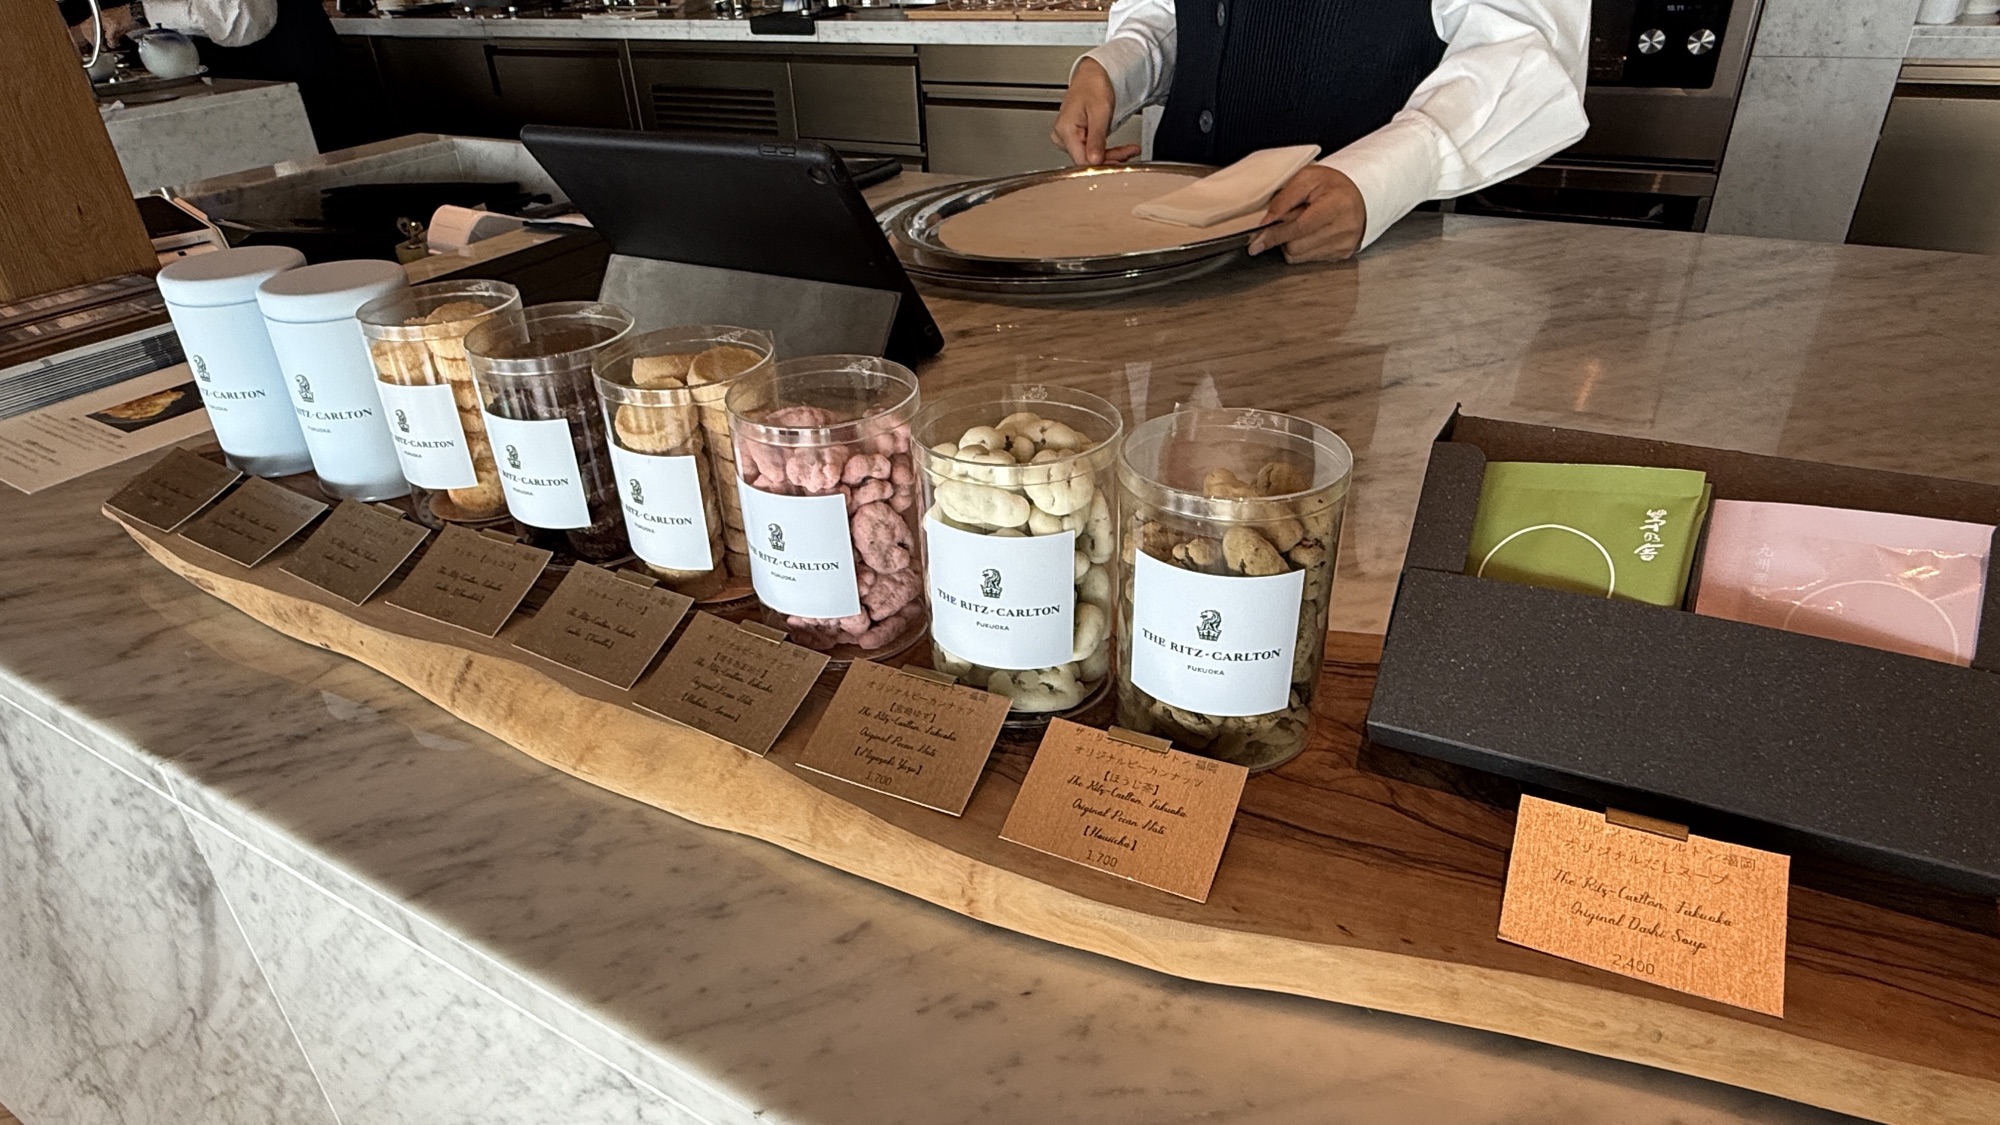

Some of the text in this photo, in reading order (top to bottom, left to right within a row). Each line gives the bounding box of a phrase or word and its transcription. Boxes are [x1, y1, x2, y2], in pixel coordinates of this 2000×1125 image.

[625, 503, 693, 525] RITZ-CARLTON
[758, 550, 840, 571] RITZ-CARLTON
[937, 587, 1061, 618] THE RITZ-CARLTON
[975, 620, 1010, 632] FUKUOKA
[1142, 627, 1282, 663] THE RITZ-CARLTON
[1186, 664, 1225, 677] FUKUOKA
[1067, 775, 1084, 788] The
[1148, 799, 1188, 818] Fukuoka
[1072, 798, 1167, 836] Original Pecan Nuts
[1086, 849, 1119, 868] 1,700
[1552, 868, 1576, 886] The
[1674, 900, 1734, 927] Fukuoka
[1571, 901, 1707, 955] Original Dashi Soup
